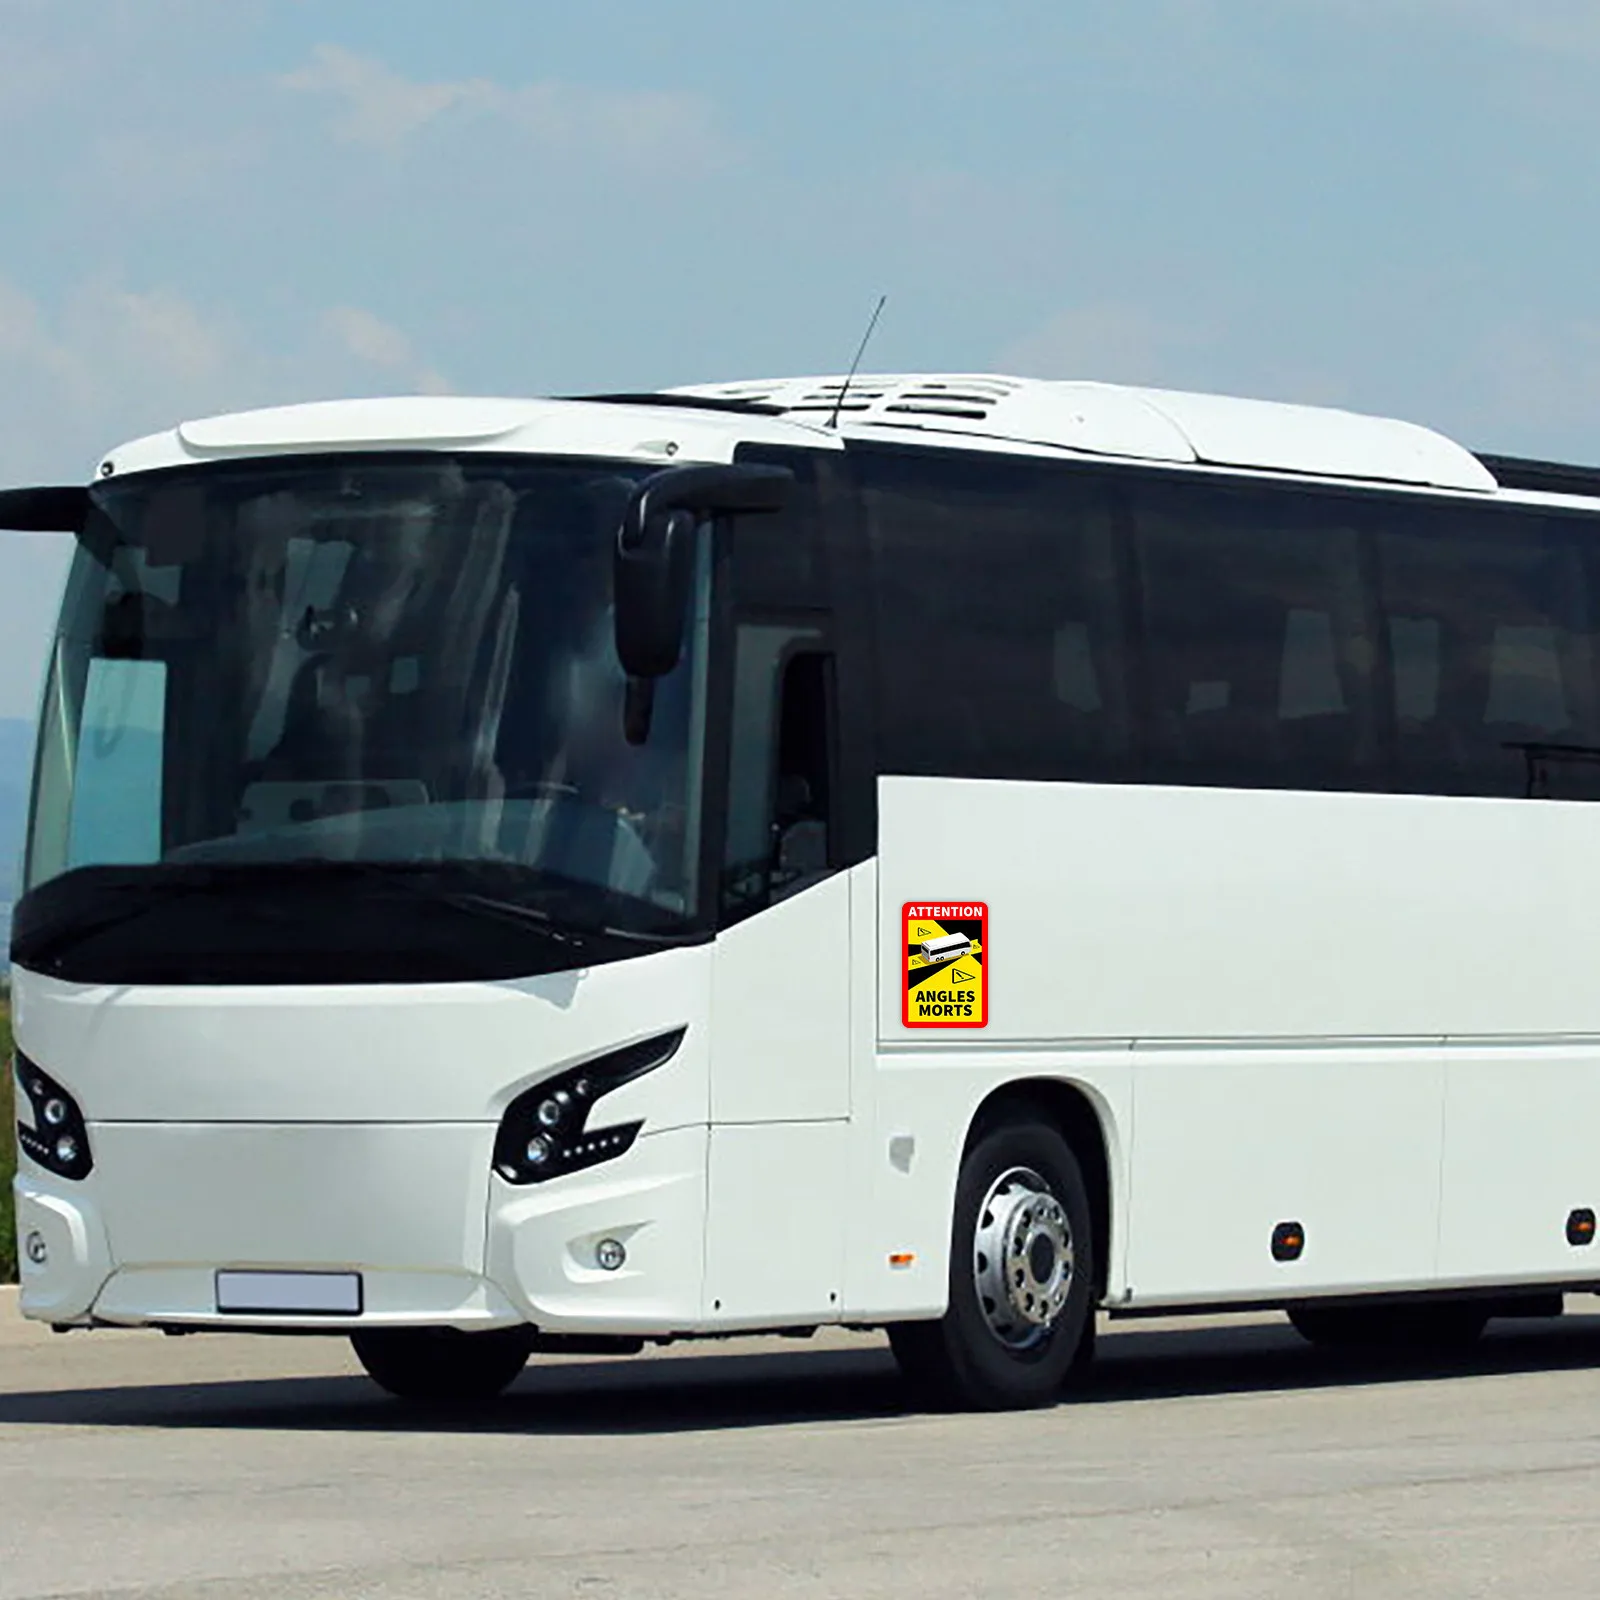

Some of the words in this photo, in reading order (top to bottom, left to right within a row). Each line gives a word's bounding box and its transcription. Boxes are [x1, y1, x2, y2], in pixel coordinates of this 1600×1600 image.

[908, 906, 983, 917] ATTENTION
[915, 990, 975, 1002] ANGLES
[918, 1004, 973, 1017] MORTS
